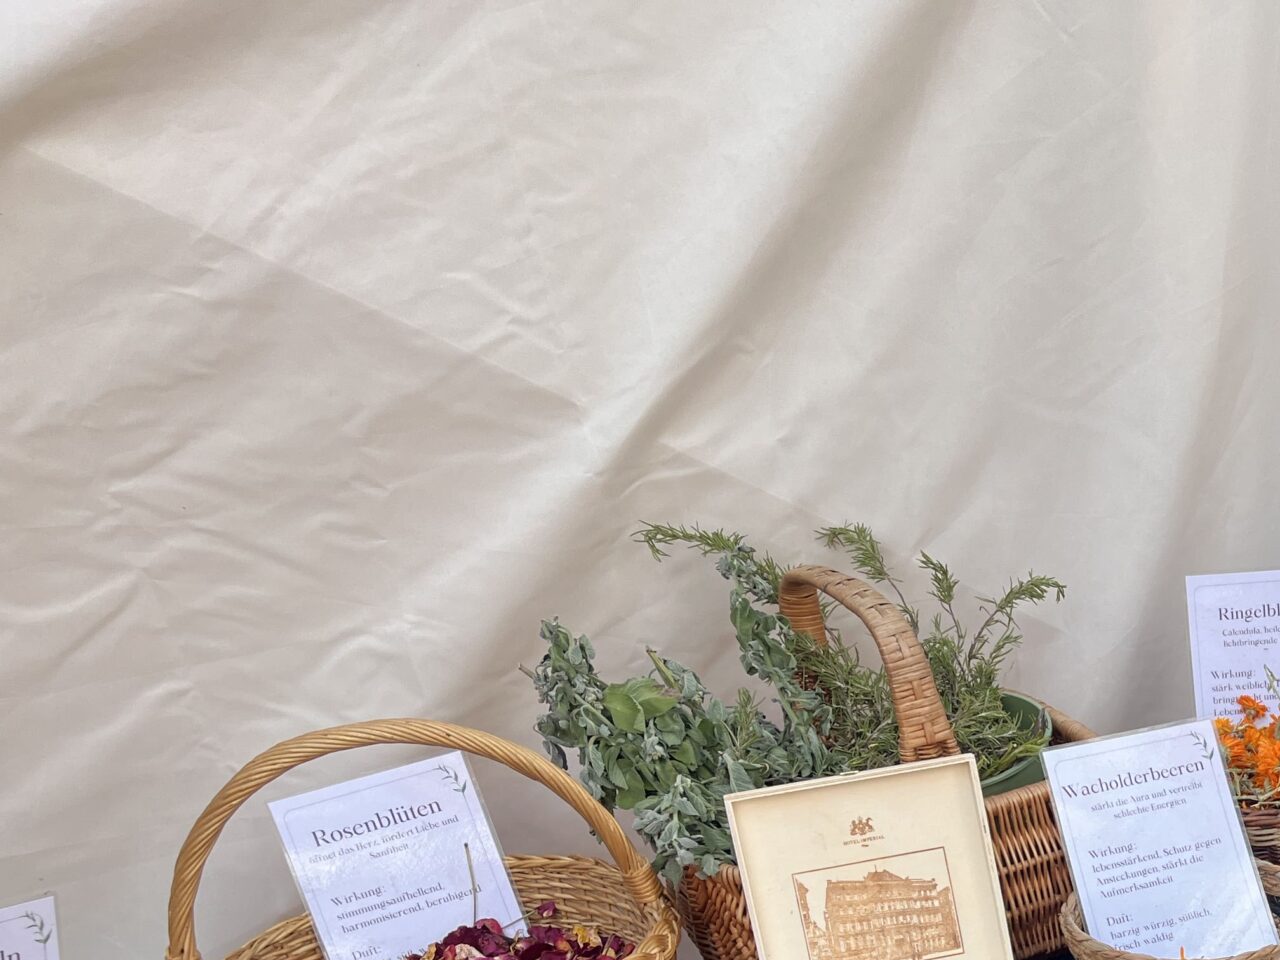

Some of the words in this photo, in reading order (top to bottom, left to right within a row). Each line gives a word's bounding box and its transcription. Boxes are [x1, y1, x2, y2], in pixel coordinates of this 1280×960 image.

[1061, 759, 1205, 800] Wacholderbeeren
[1151, 788, 1167, 800] und
[311, 800, 443, 848] Rosenblüten
[442, 814, 460, 826] und
[1088, 841, 1138, 859] Wirkung:
[1162, 844, 1193, 858] Schutz
[1194, 837, 1223, 852] gegen
[1161, 858, 1188, 872] stärkt
[1189, 854, 1205, 865] die
[1100, 874, 1175, 900] Aufmerksamkeit
[1106, 912, 1133, 927] Duft:
[1110, 925, 1141, 941] harzig
[1144, 931, 1175, 946] waldig
